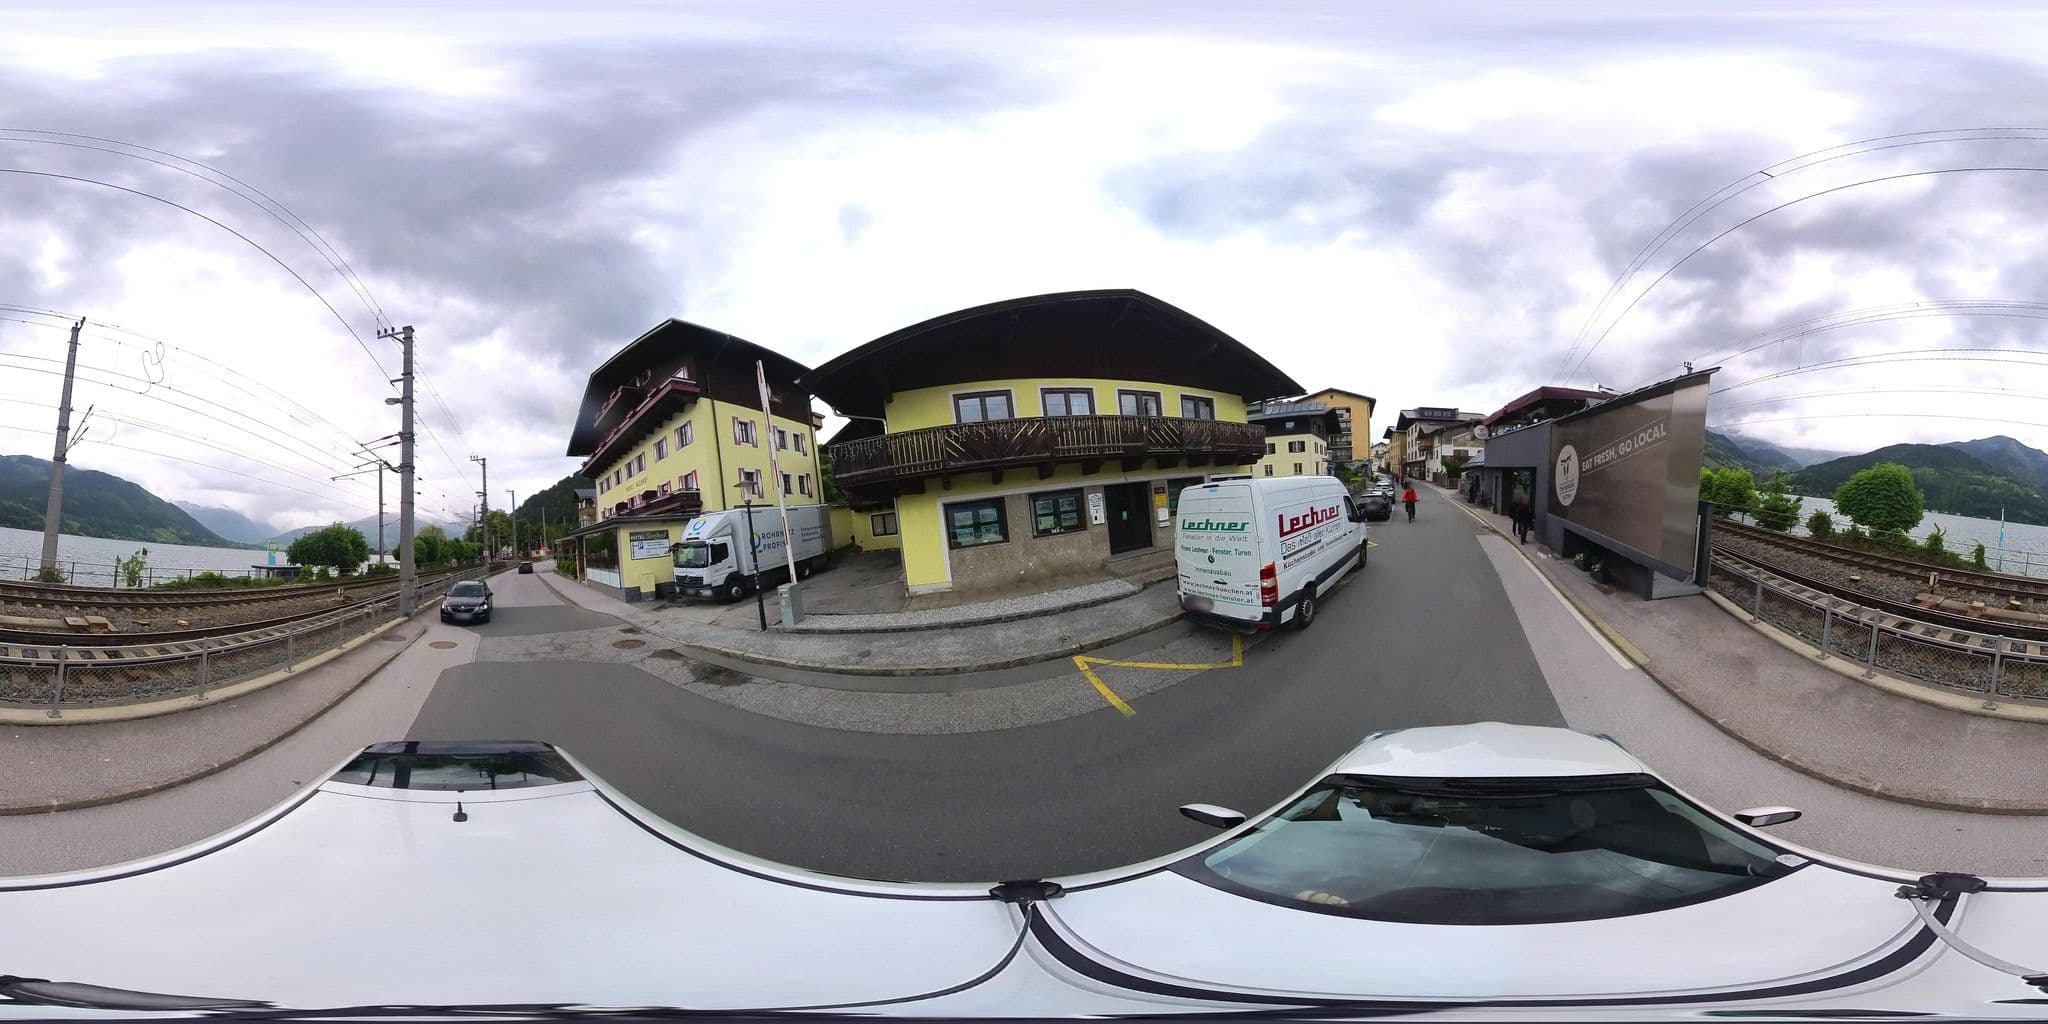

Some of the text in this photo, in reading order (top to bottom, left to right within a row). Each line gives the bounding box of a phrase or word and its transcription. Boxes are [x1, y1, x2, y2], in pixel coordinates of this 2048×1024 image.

[1582, 423, 1666, 472] EAT FRESH, GO LOCAL
[1182, 519, 1249, 531] Lechner
[1278, 505, 1341, 538] Lechner
[630, 533, 645, 541] HOTEL
[1214, 534, 1226, 542] die
[1228, 534, 1249, 542] Welt
[1281, 541, 1296, 555] Das
[1195, 566, 1232, 576] Innenausbau
